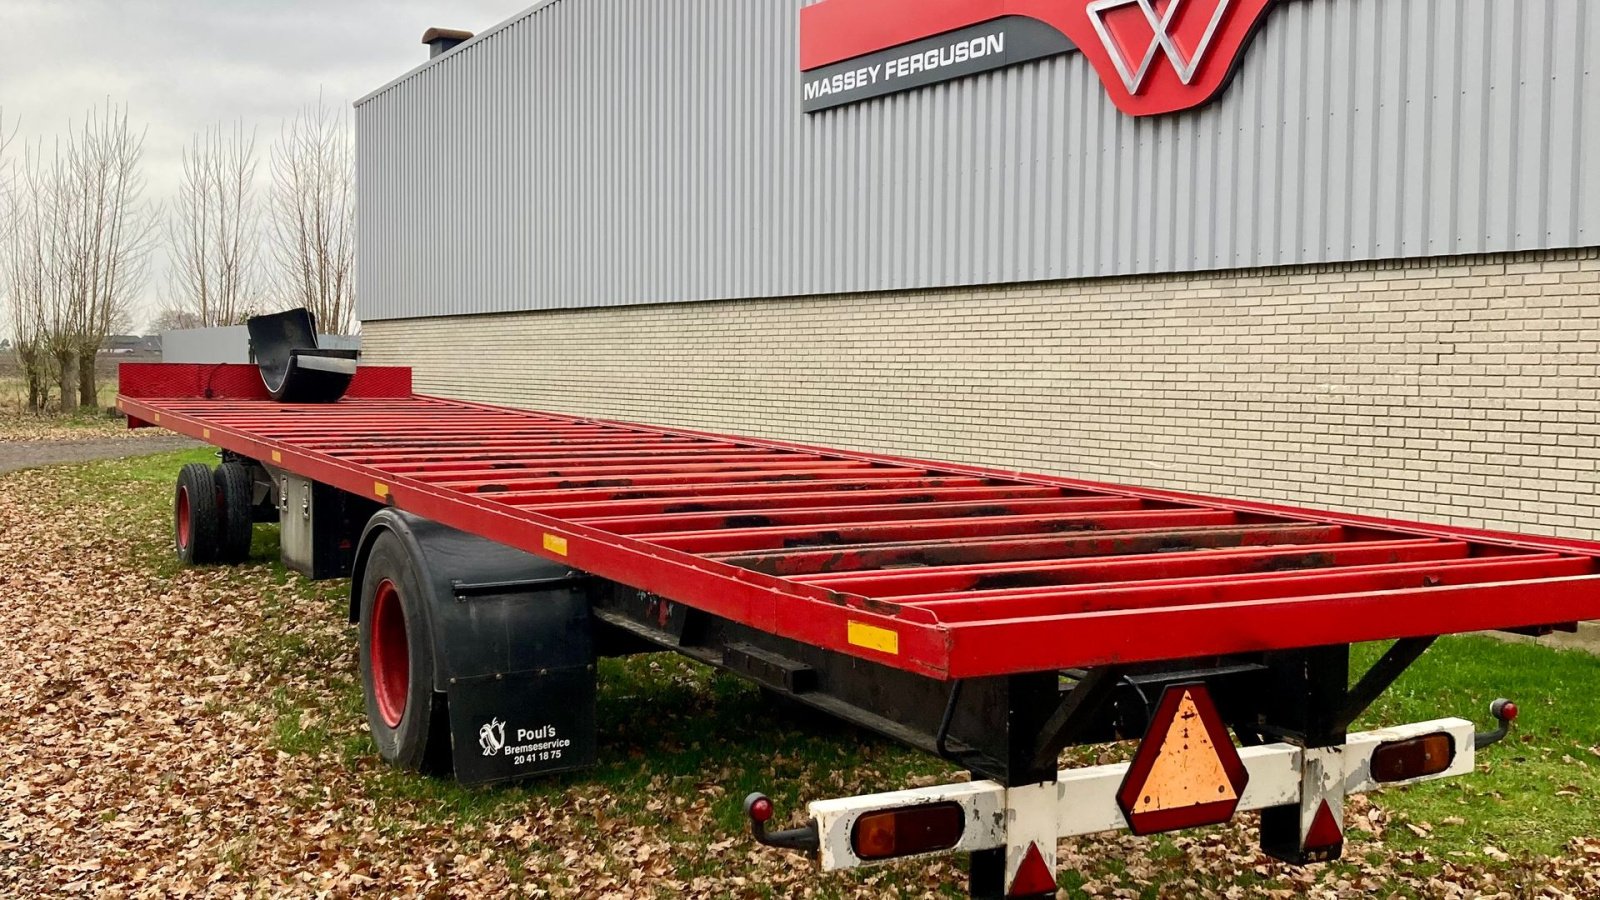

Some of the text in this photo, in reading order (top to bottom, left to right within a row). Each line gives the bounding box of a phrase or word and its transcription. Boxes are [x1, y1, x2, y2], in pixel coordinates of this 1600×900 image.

[804, 32, 1004, 100] MASSEY FERGUSON
[504, 739, 570, 755] Bremseservice
[514, 749, 562, 765] 20 41 18 75
